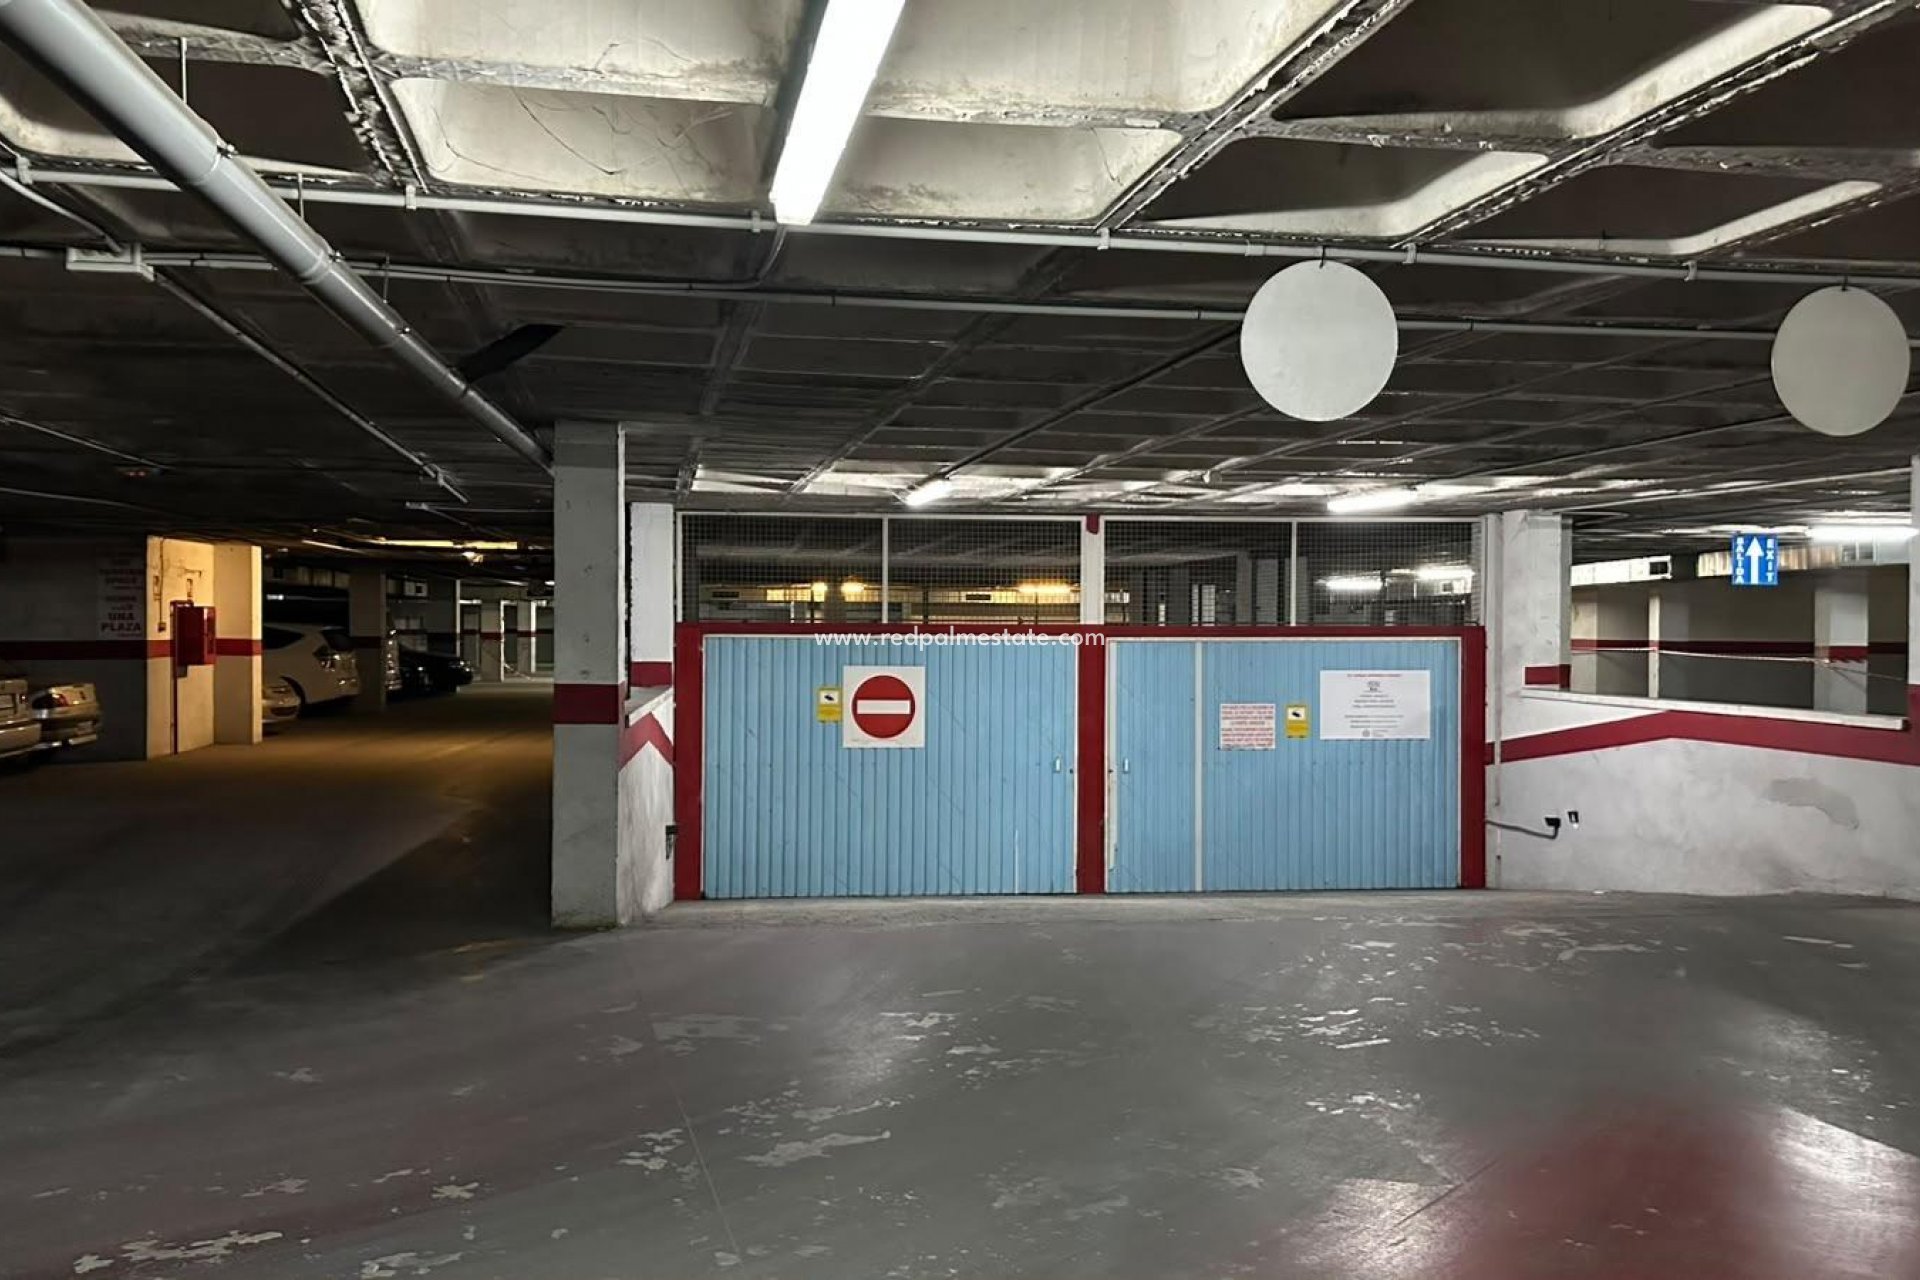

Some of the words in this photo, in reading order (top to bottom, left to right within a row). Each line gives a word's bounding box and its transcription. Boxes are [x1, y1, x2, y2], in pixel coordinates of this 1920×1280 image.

[1735, 537, 1745, 585] SALIDA
[1765, 538, 1775, 583] EXIT
[101, 622, 141, 632] PLAZA
